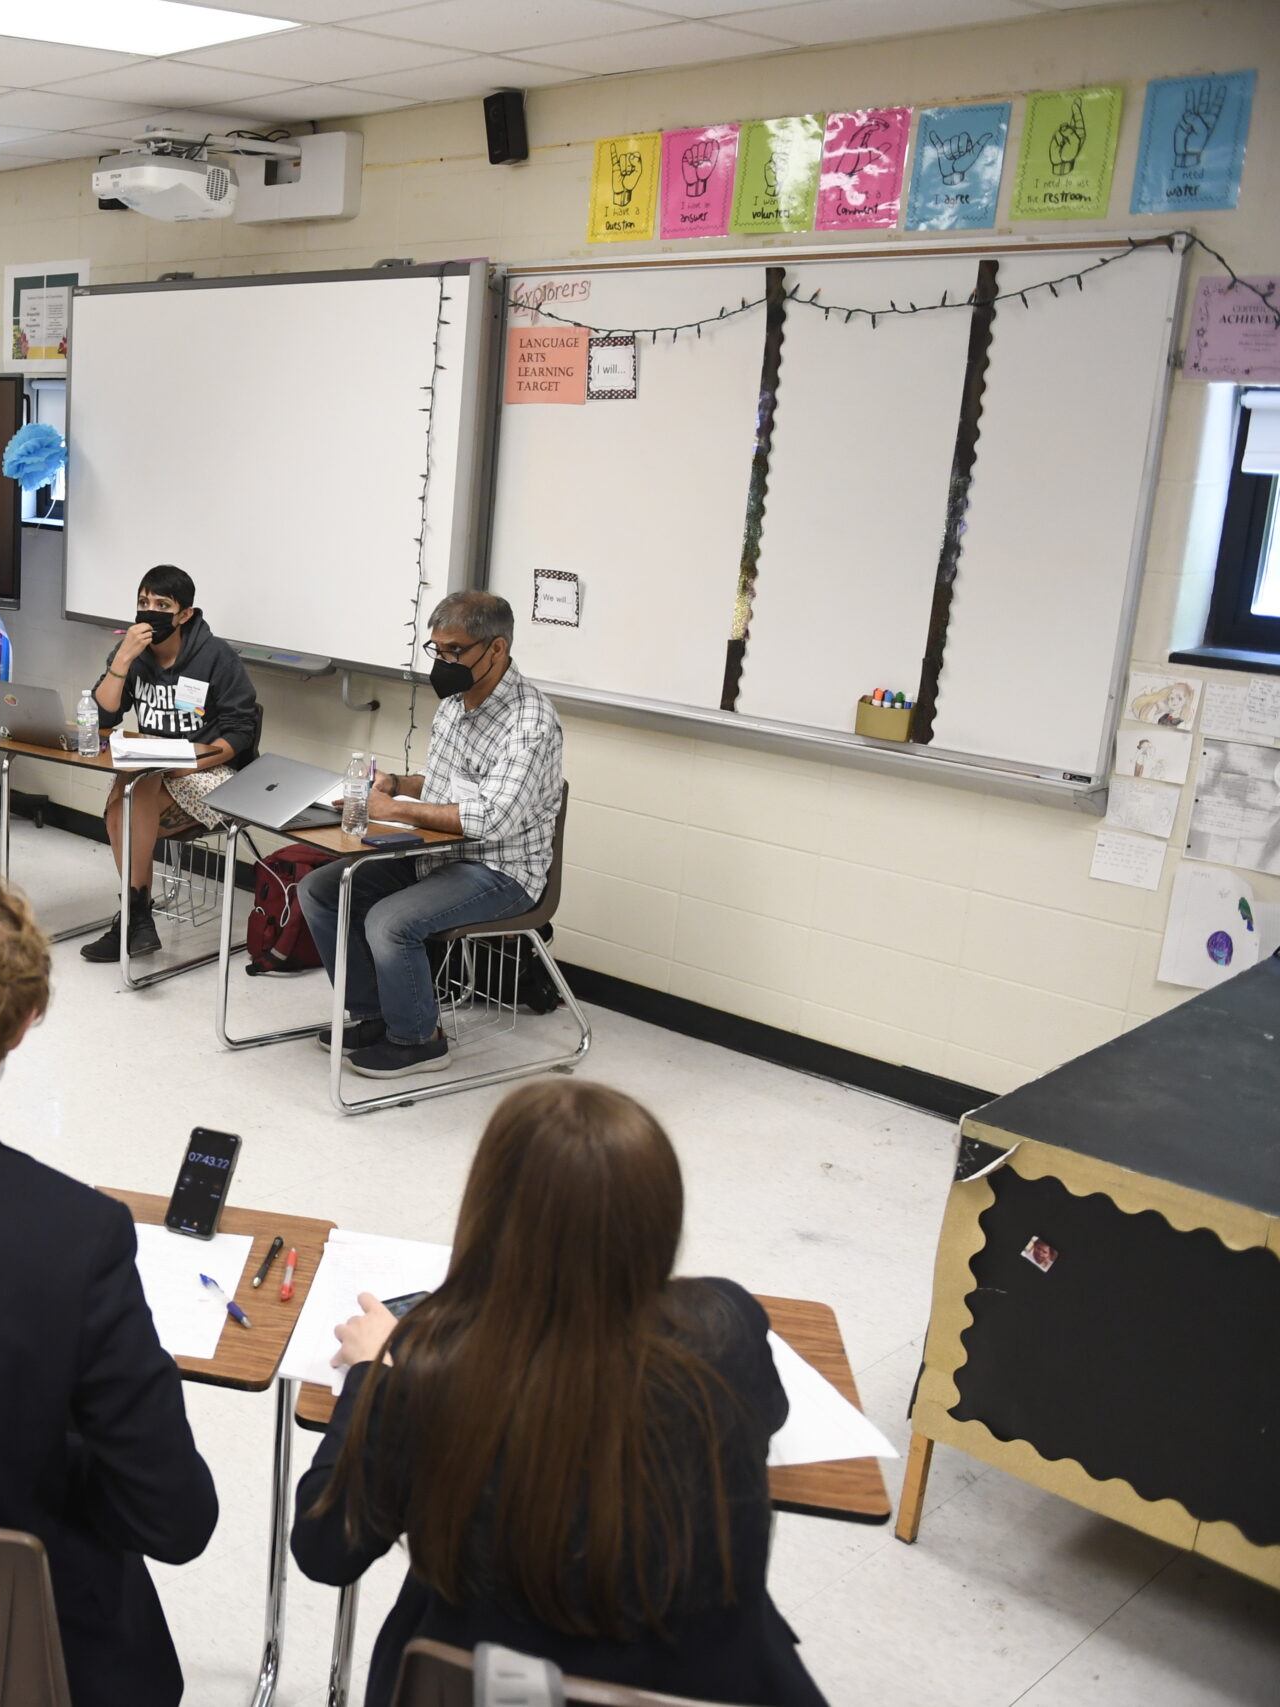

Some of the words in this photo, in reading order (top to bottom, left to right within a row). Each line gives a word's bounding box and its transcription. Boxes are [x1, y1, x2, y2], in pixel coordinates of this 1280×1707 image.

[1182, 168, 1204, 179] need
[1044, 178, 1060, 188] need
[1166, 184, 1200, 197] water
[944, 194, 970, 210] agree
[1043, 190, 1092, 204] restroom
[613, 208, 630, 216] have
[680, 212, 708, 223] answer
[512, 280, 589, 325] Explorers
[519, 337, 580, 348] LANGUAGE
[518, 353, 546, 363] ARTS
[517, 367, 574, 377] LEARNING
[516, 381, 561, 391] TARGET
